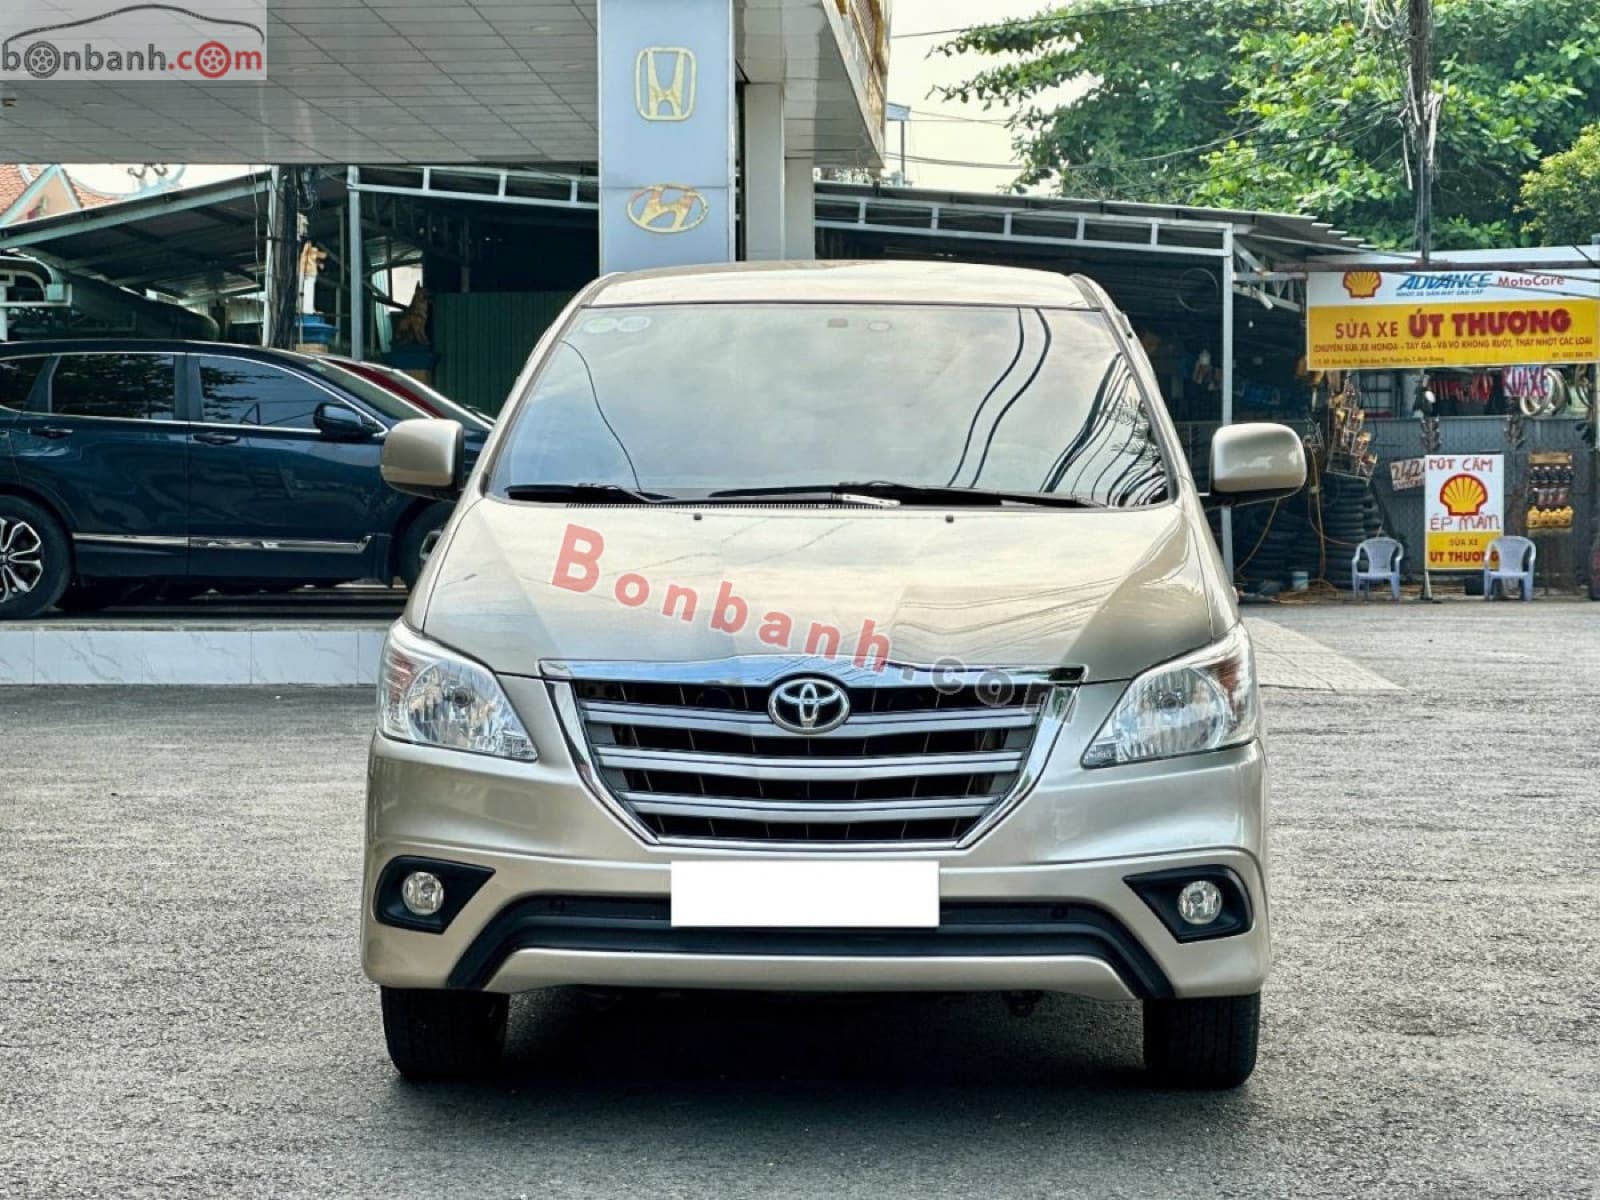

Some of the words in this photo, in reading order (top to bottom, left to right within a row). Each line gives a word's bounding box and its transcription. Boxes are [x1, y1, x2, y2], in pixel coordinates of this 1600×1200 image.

[1397, 273, 1493, 290] ADVANCE
[1497, 275, 1565, 288] MotoCare
[1376, 320, 1398, 338] XE
[1408, 308, 1445, 338] ÚT
[1451, 308, 1572, 337] THƯƠNG
